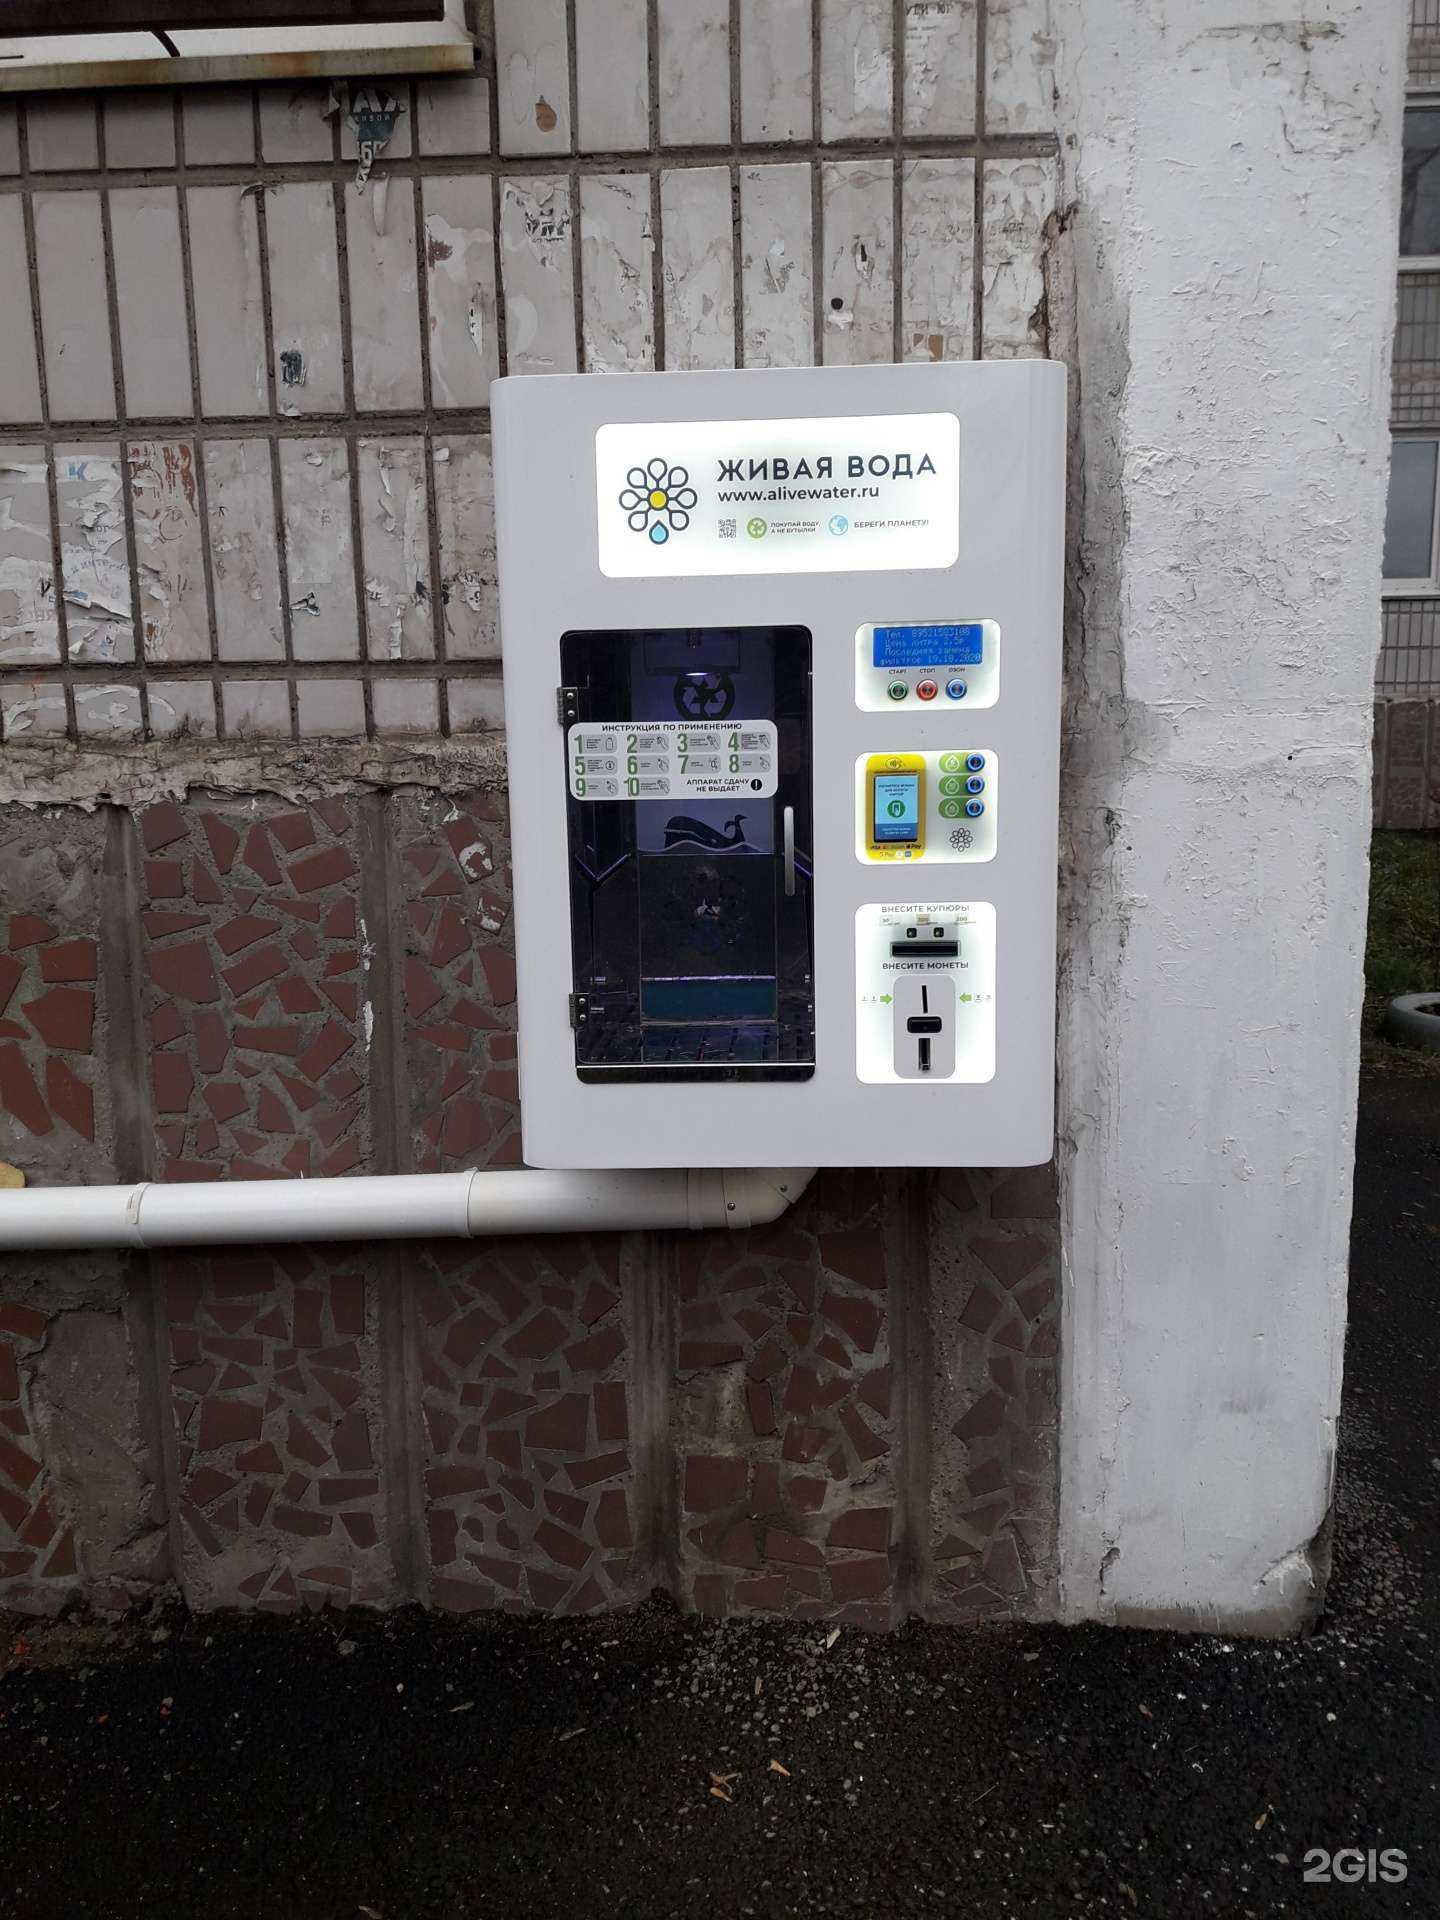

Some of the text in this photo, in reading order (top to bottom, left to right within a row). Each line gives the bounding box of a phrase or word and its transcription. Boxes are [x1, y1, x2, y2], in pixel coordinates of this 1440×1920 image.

[717, 453, 937, 482] ЖИВАЯ ВОДА
[717, 486, 880, 503] www.alivewater.ru
[854, 519, 929, 529] БЕРЕГИ ПЛАНЕТУ!
[602, 724, 660, 732] ИНСТРУКЦИЯ
[678, 723, 742, 731] ПРИМЕНЕНИЮ
[574, 735, 583, 754] 1
[627, 734, 638, 753] 2
[677, 734, 688, 752] 3
[728, 732, 740, 751] 4
[575, 756, 586, 775] 5
[627, 755, 638, 775] 6
[678, 755, 690, 774] 7
[729, 754, 740, 773] 8
[576, 778, 587, 797] 9
[624, 777, 639, 797] 10
[708, 785, 740, 793] ВЫДАЕТ
[724, 778, 749, 786] СДАЧУ
[881, 904, 970, 913] ВНЕСИТЕ КУПЮРЫ
[927, 962, 969, 970] МОНЕТЫ
